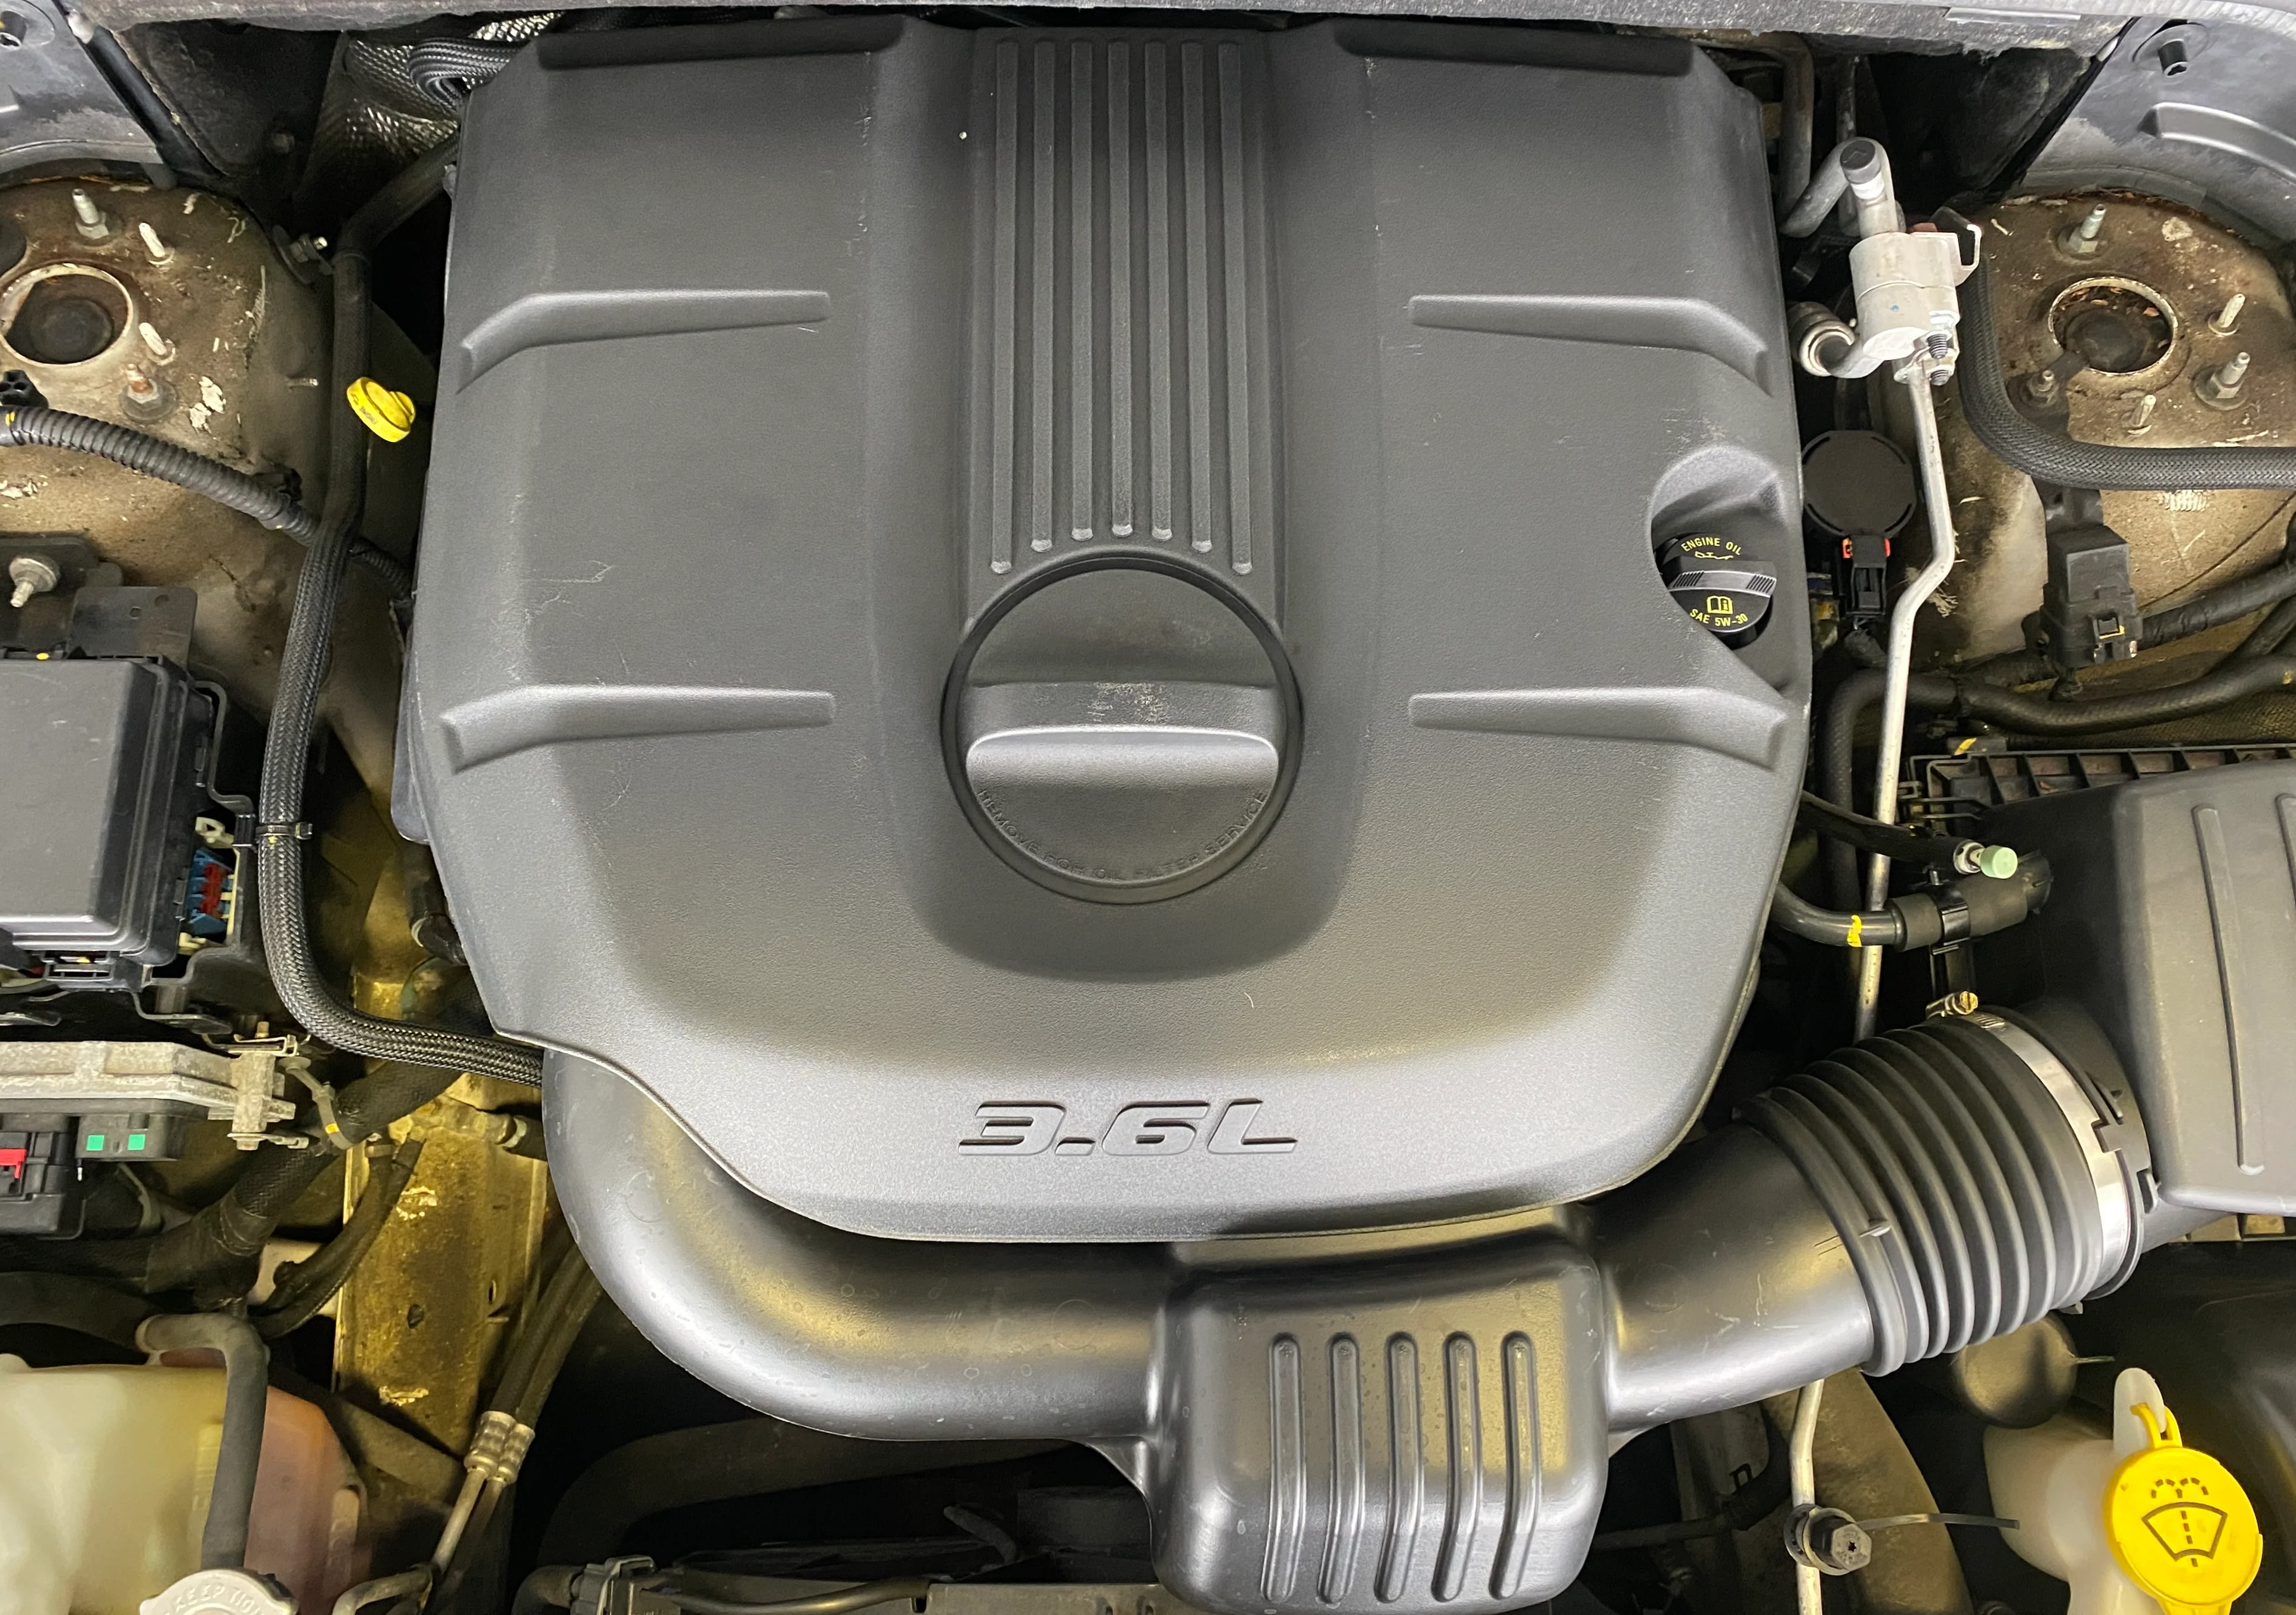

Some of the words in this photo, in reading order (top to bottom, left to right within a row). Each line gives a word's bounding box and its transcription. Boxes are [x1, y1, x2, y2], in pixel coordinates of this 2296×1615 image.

[1681, 537, 1721, 552] ENGINE
[1726, 542, 1742, 555] OIL
[1690, 609, 1711, 624] SAE
[1715, 613, 1748, 626] 5W-30
[1043, 853, 1085, 875] FOR
[1205, 792, 1267, 856] SERVICE
[958, 1098, 1298, 1156] 3.6L
